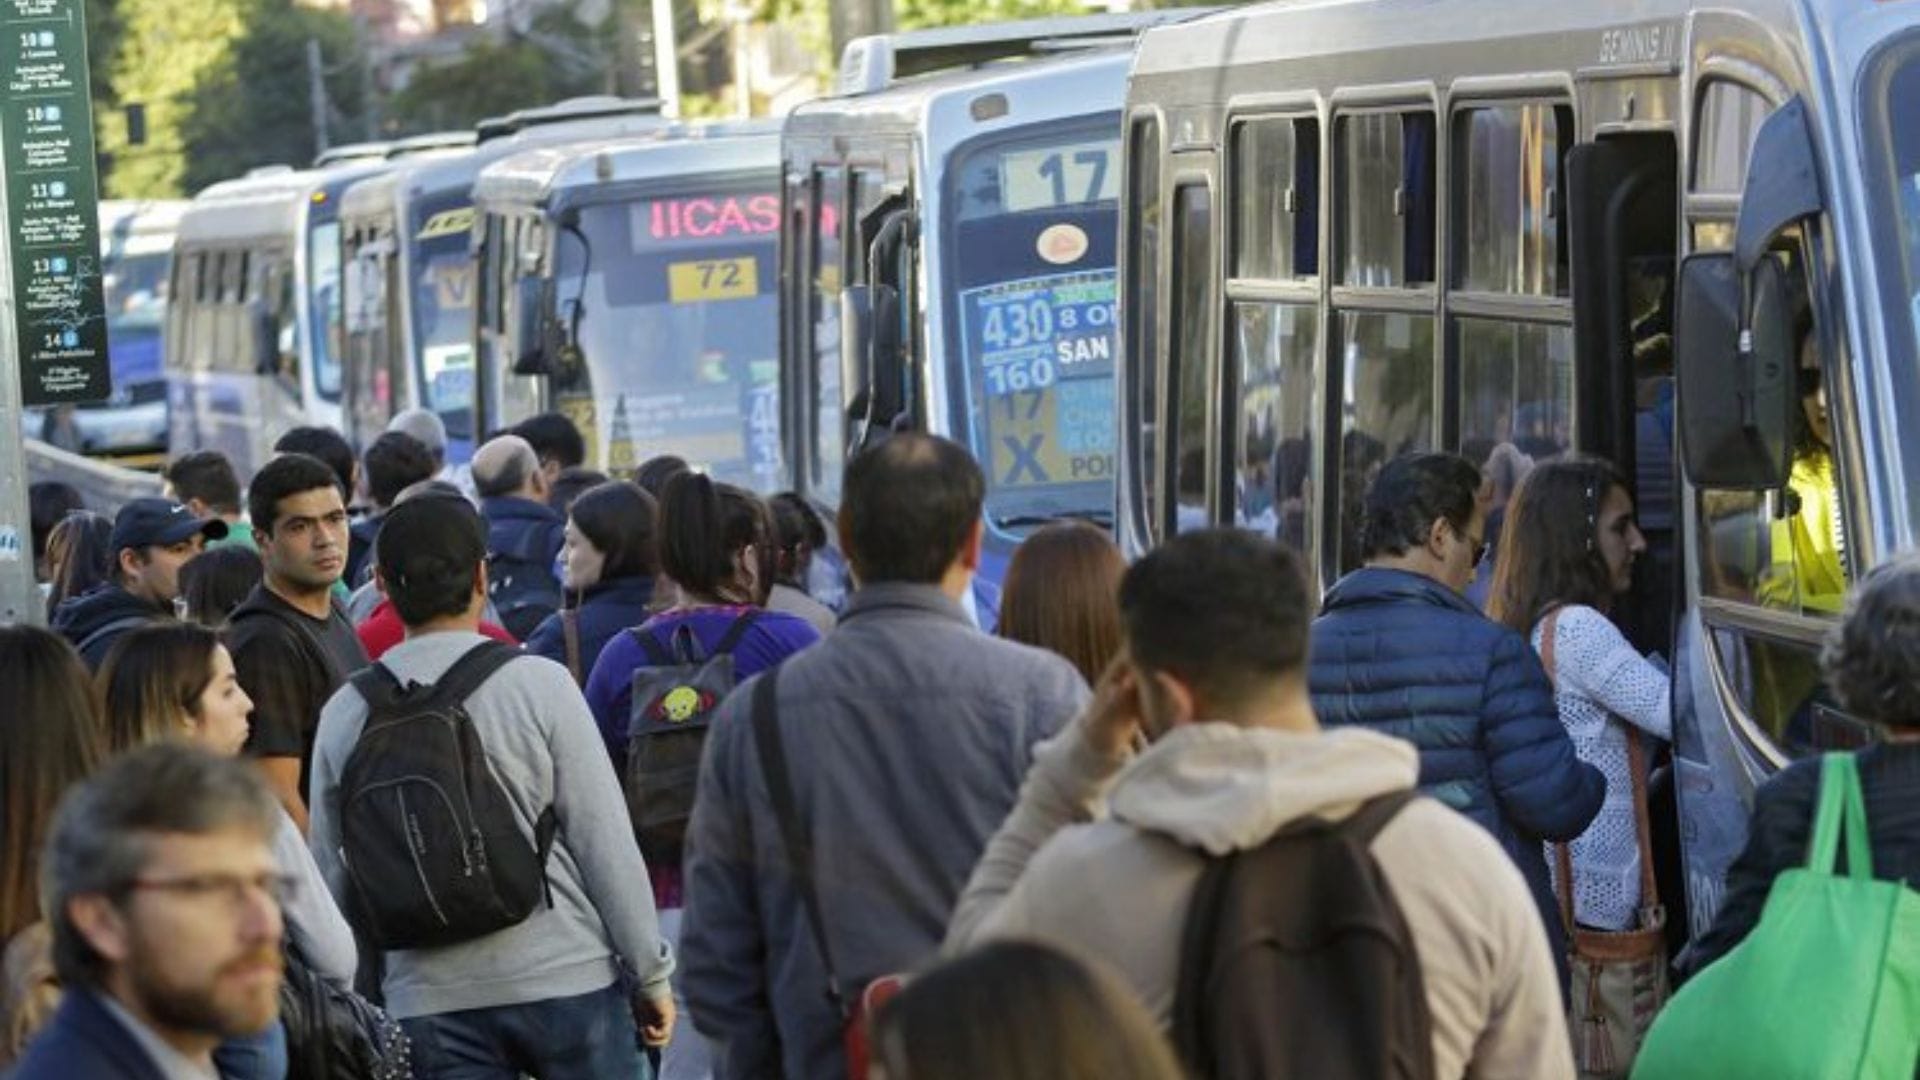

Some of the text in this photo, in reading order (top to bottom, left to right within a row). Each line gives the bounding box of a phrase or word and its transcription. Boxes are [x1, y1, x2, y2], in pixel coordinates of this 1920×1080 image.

[1038, 150, 1109, 203] 17
[695, 261, 742, 290] 72
[983, 298, 1054, 347] 430
[1057, 336, 1110, 365] SAN
[987, 356, 1055, 395] 160
[1001, 433, 1050, 484] X
